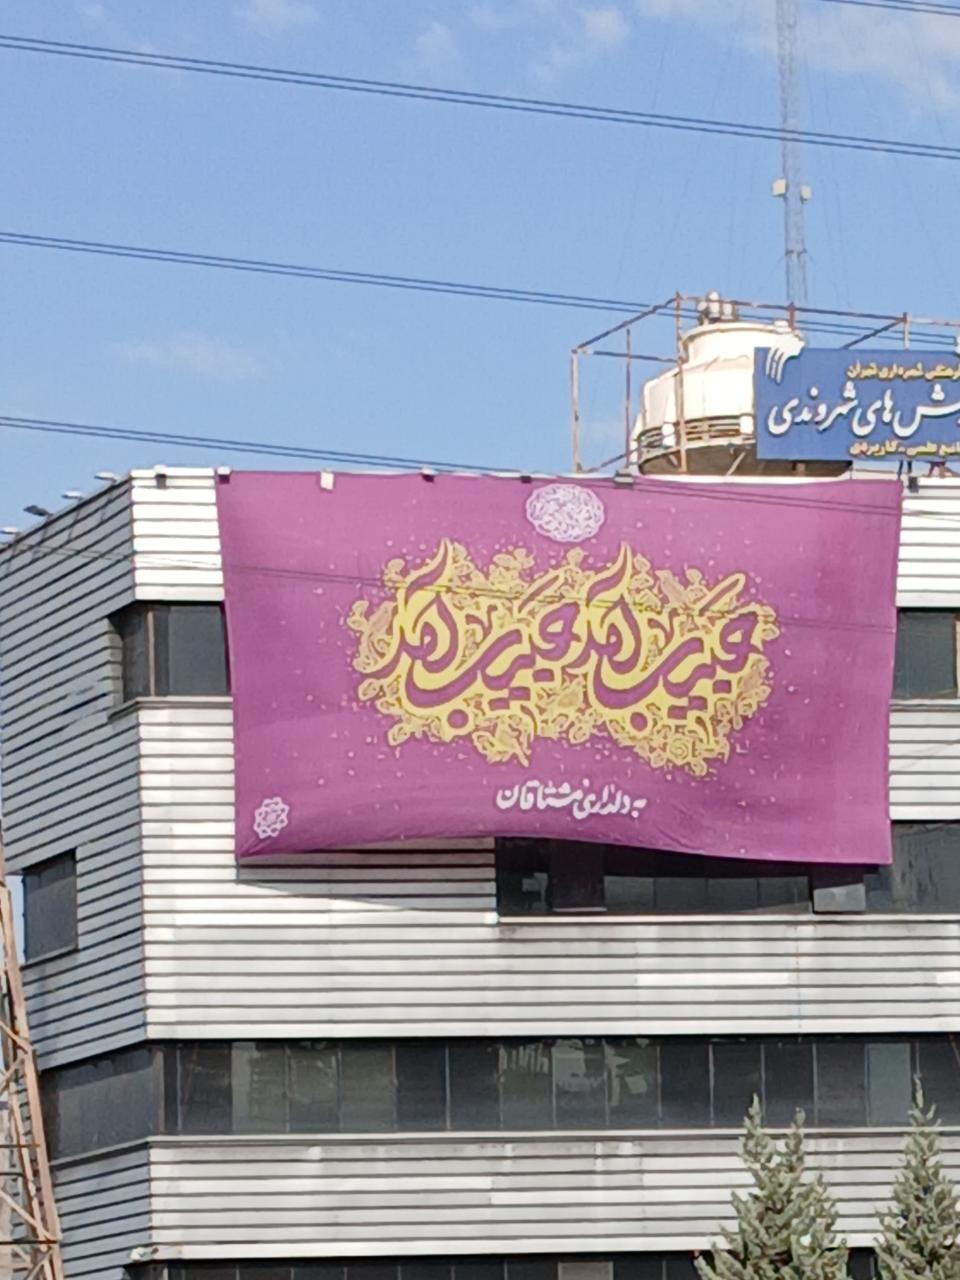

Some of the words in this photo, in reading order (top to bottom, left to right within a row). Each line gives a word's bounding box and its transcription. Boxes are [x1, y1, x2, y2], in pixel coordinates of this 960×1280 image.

[847, 360, 877, 379] تهران
[767, 380, 859, 435] شهروندی
[852, 388, 893, 437] های
[496, 778, 585, 810] مشتاقان
[572, 783, 631, 820] دلداری
[631, 798, 648, 819] به
